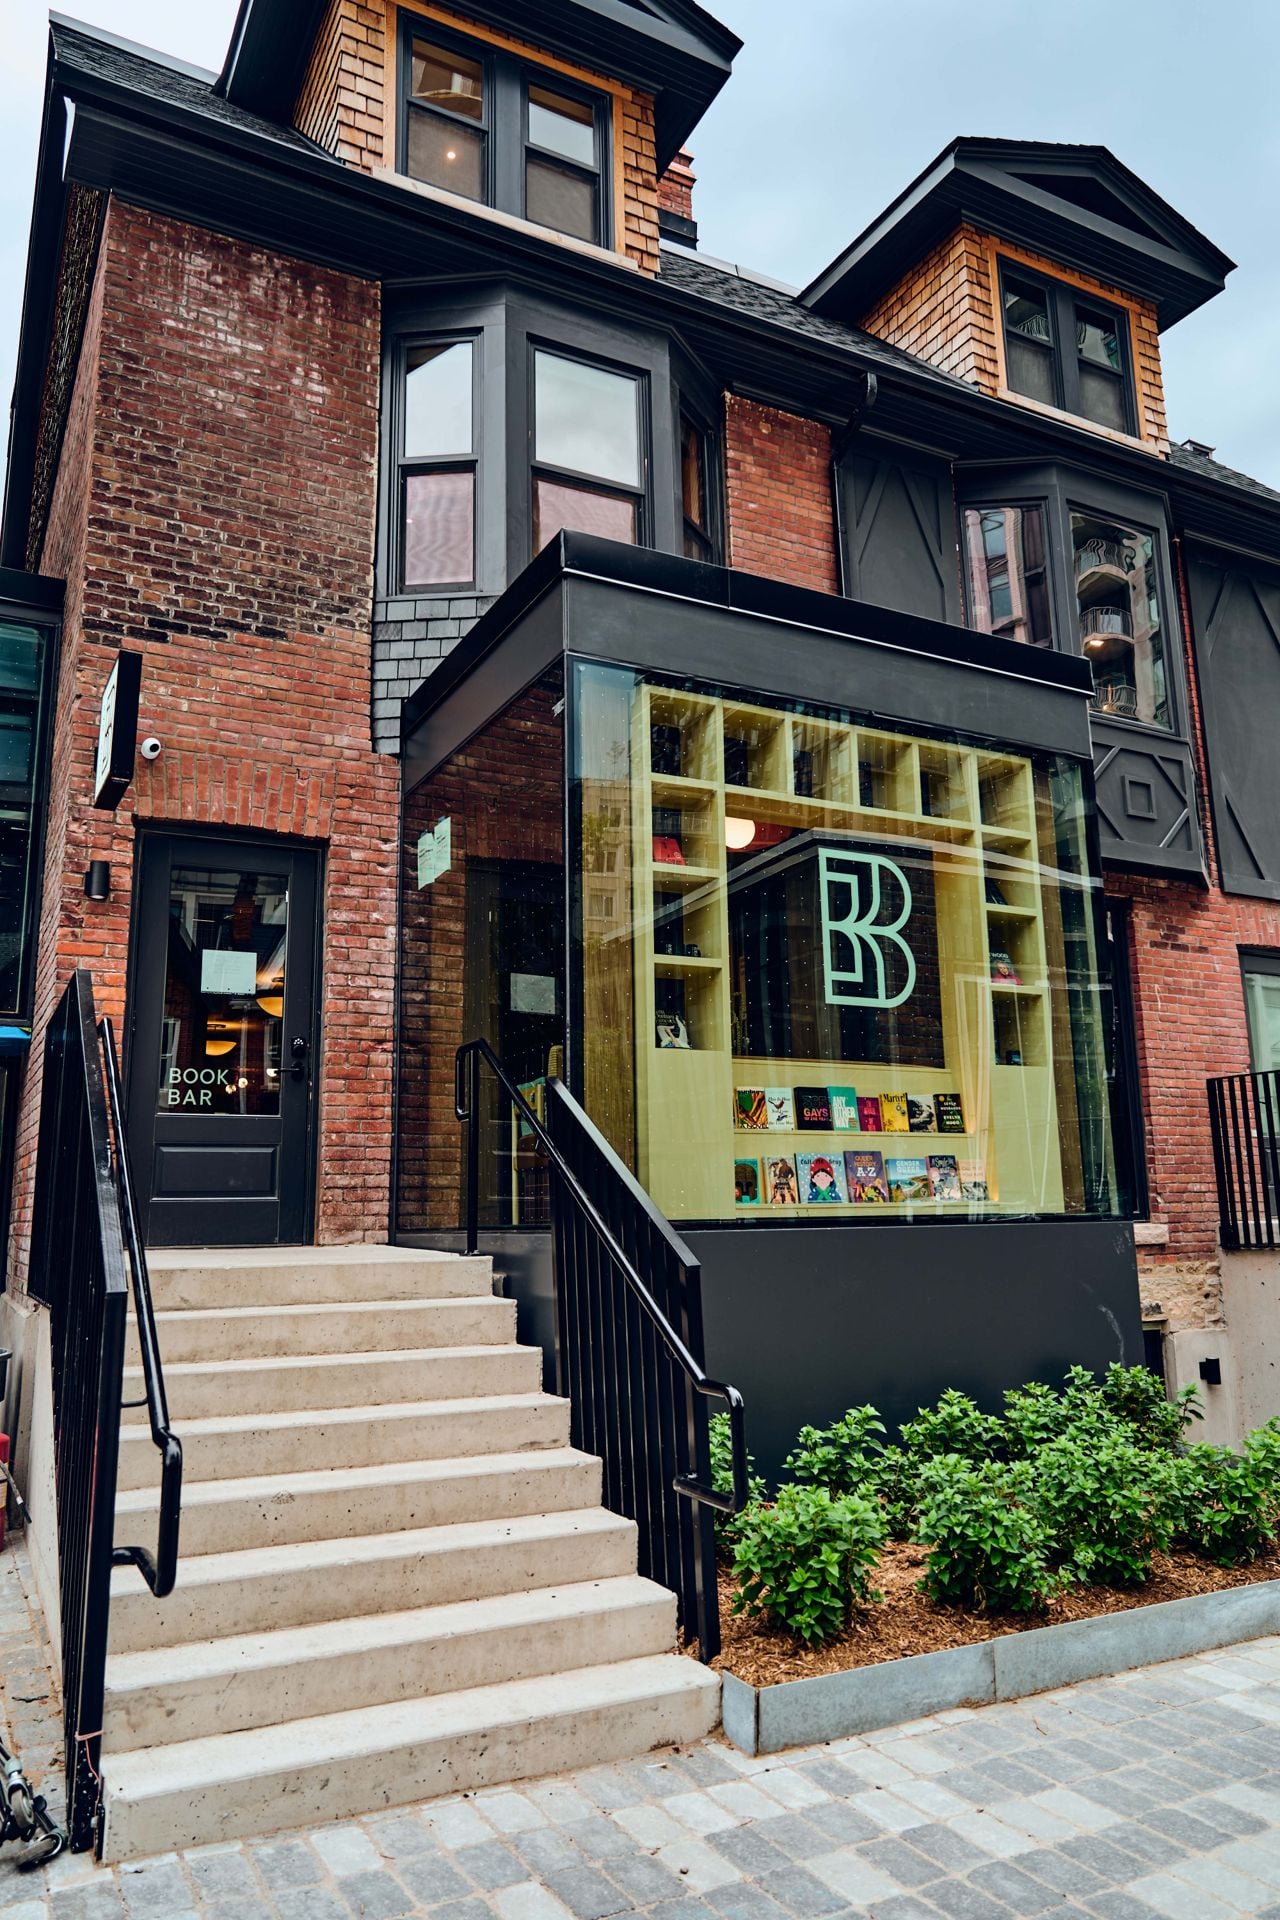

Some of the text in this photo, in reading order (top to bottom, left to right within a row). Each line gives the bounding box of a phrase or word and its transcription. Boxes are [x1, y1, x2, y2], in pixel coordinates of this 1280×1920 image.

[169, 1067, 229, 1085] BOOK
[168, 1088, 212, 1106] BAR
[833, 1096, 846, 1107] ANY
[883, 1093, 906, 1103] Martyr!
[803, 1108, 828, 1117] GAYS
[835, 1117, 849, 1128] WAY
